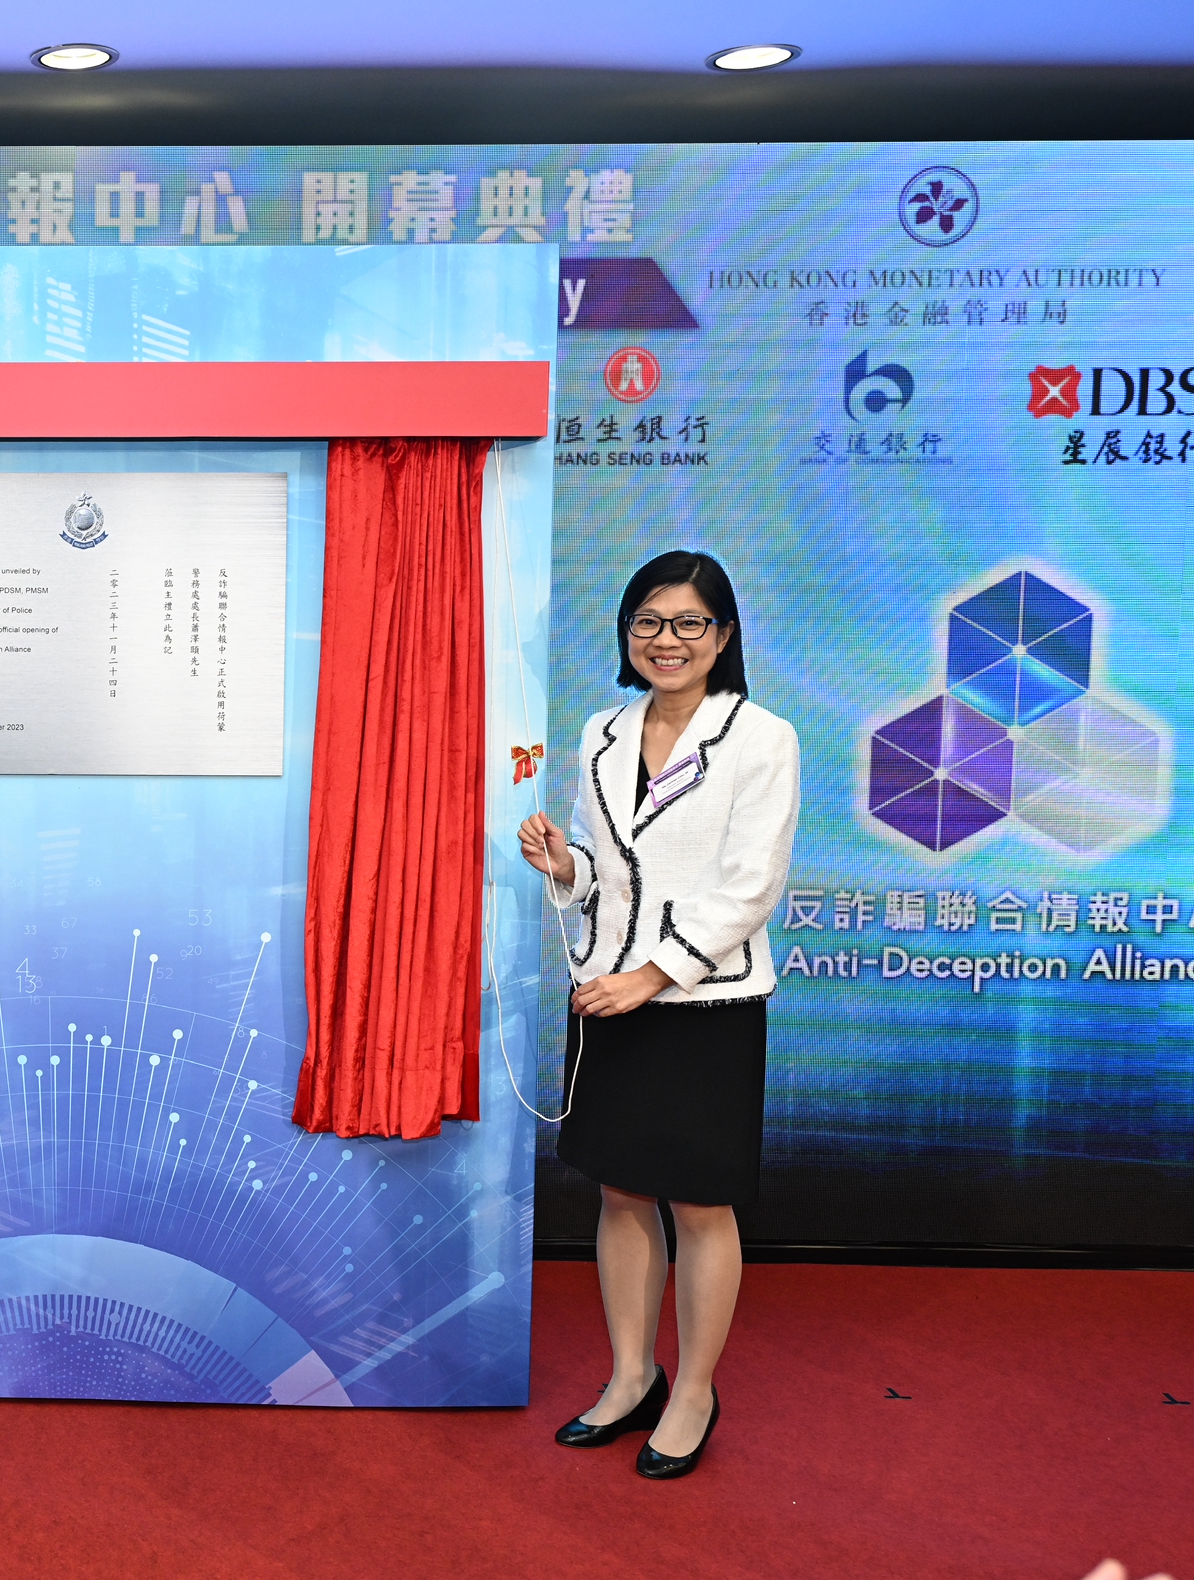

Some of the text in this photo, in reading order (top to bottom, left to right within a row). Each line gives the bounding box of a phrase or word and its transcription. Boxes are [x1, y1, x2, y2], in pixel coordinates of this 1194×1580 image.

[302, 169, 635, 244] 開幕典禮
[708, 268, 1167, 289] HONG KONG MONETARY AUTHORITY
[805, 300, 1068, 327] 香港金融管理局
[607, 452, 653, 466] SENG
[660, 452, 709, 466] BANK
[1, 567, 31, 575] unveiled
[32, 567, 41, 576] by
[0, 586, 24, 595] PDSM,
[25, 586, 49, 594] PMSM
[2, 606, 10, 614] of
[11, 606, 33, 614] Police
[22, 626, 50, 635] opening
[51, 626, 59, 634] of
[108, 569, 120, 698] 二零二三年十一月二十四日
[4, 645, 32, 653] Alliance
[6, 723, 25, 731] 2023
[188, 909, 213, 926] 53
[782, 889, 1194, 935] 反詐騙聯合情報中
[61, 917, 77, 929] 67
[23, 925, 37, 936] 33
[51, 946, 68, 960] 37
[187, 944, 203, 956] 20
[14, 957, 31, 976] 4
[156, 967, 174, 980] 52
[781, 943, 1067, 993] Anti-Deception
[453, 1160, 467, 1176] 4
